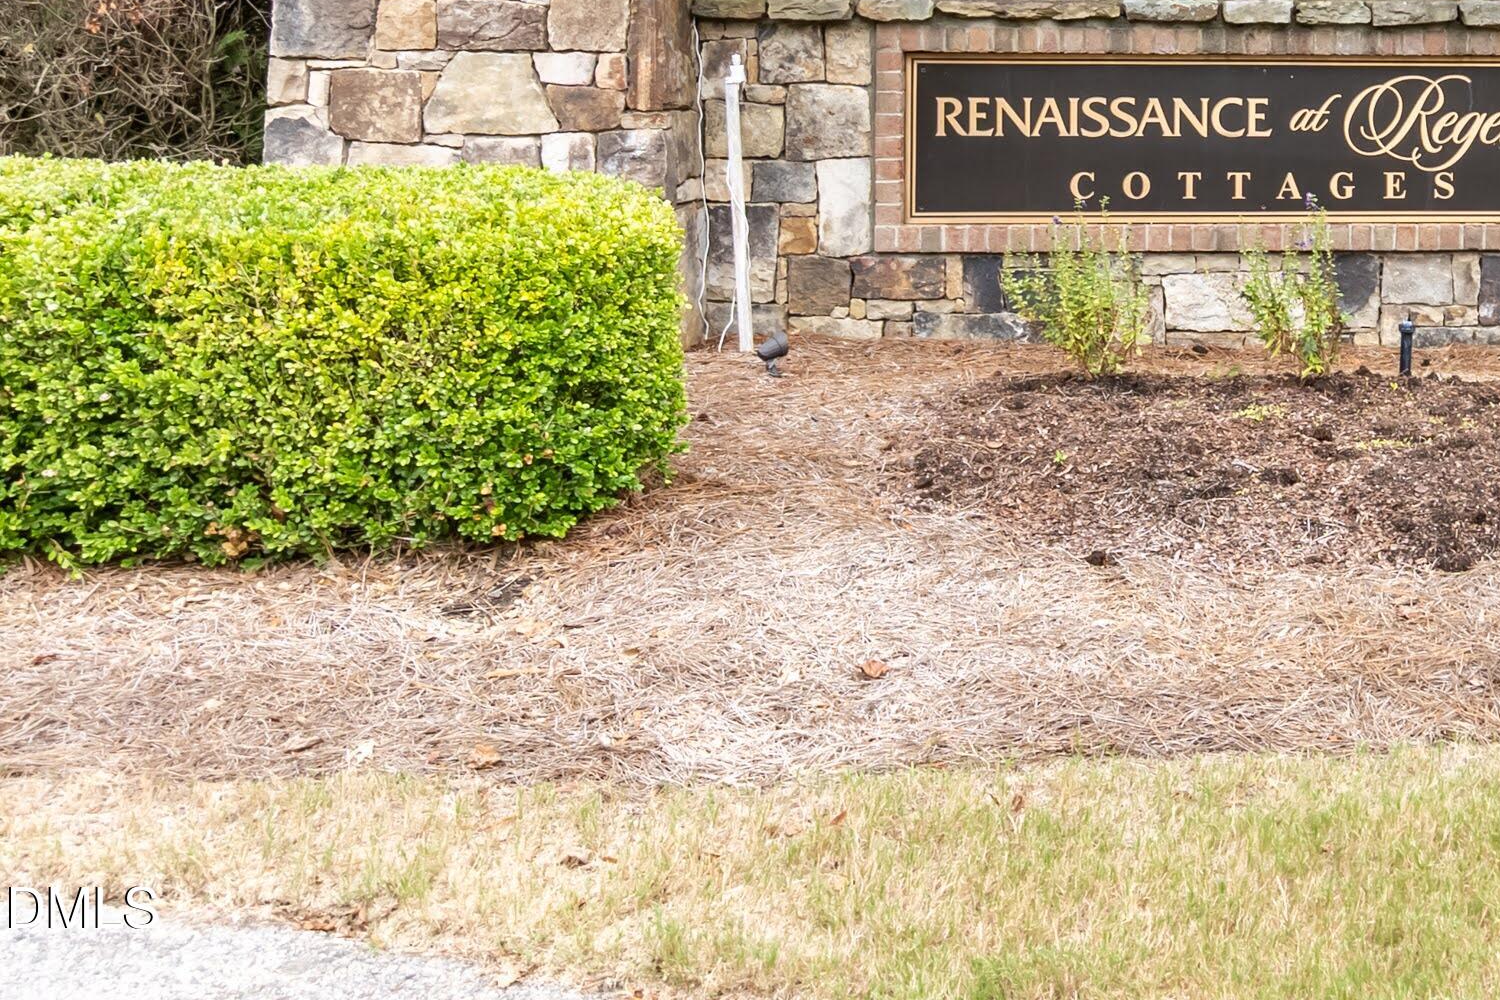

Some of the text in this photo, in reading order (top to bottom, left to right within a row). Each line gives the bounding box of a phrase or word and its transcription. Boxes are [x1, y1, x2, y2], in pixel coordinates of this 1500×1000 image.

[934, 96, 1273, 138] RENAISSANCE
[1289, 94, 1342, 132] at
[1069, 171, 1456, 200] COTTAGES
